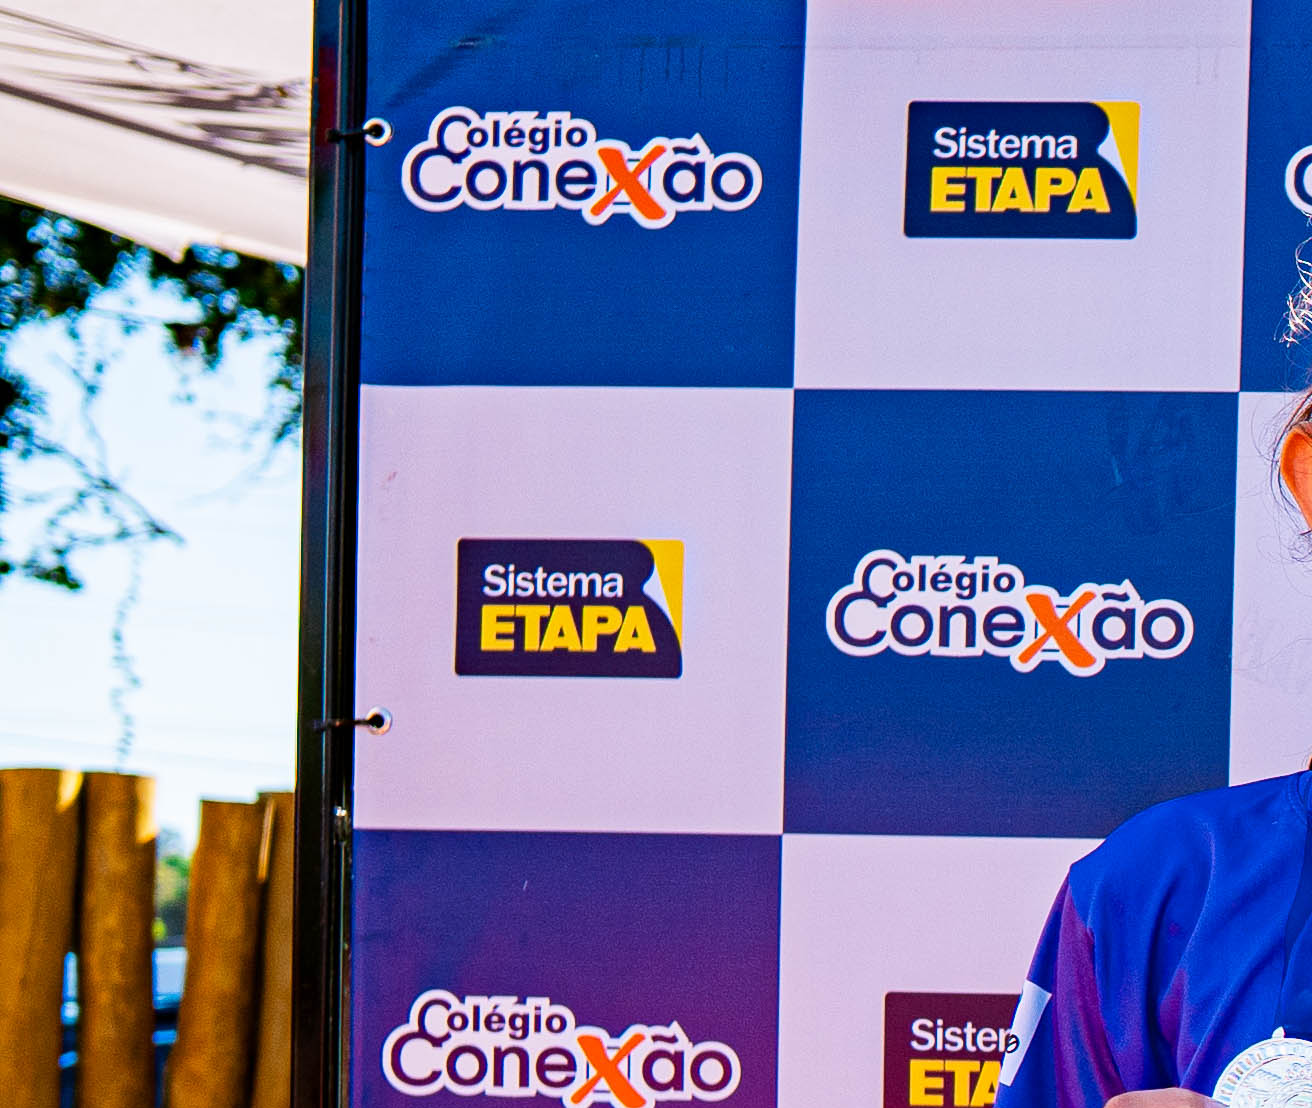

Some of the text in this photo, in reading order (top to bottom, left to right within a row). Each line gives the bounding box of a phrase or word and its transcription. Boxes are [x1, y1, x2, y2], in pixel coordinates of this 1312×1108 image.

[437, 115, 588, 156] Colégio
[932, 127, 1078, 160] Sistema
[930, 166, 1110, 212] ETAPA
[482, 564, 623, 599] Sistema
[862, 556, 1016, 600] Colégio
[480, 604, 656, 652] ETAPA
[416, 998, 566, 1040] Colégio
